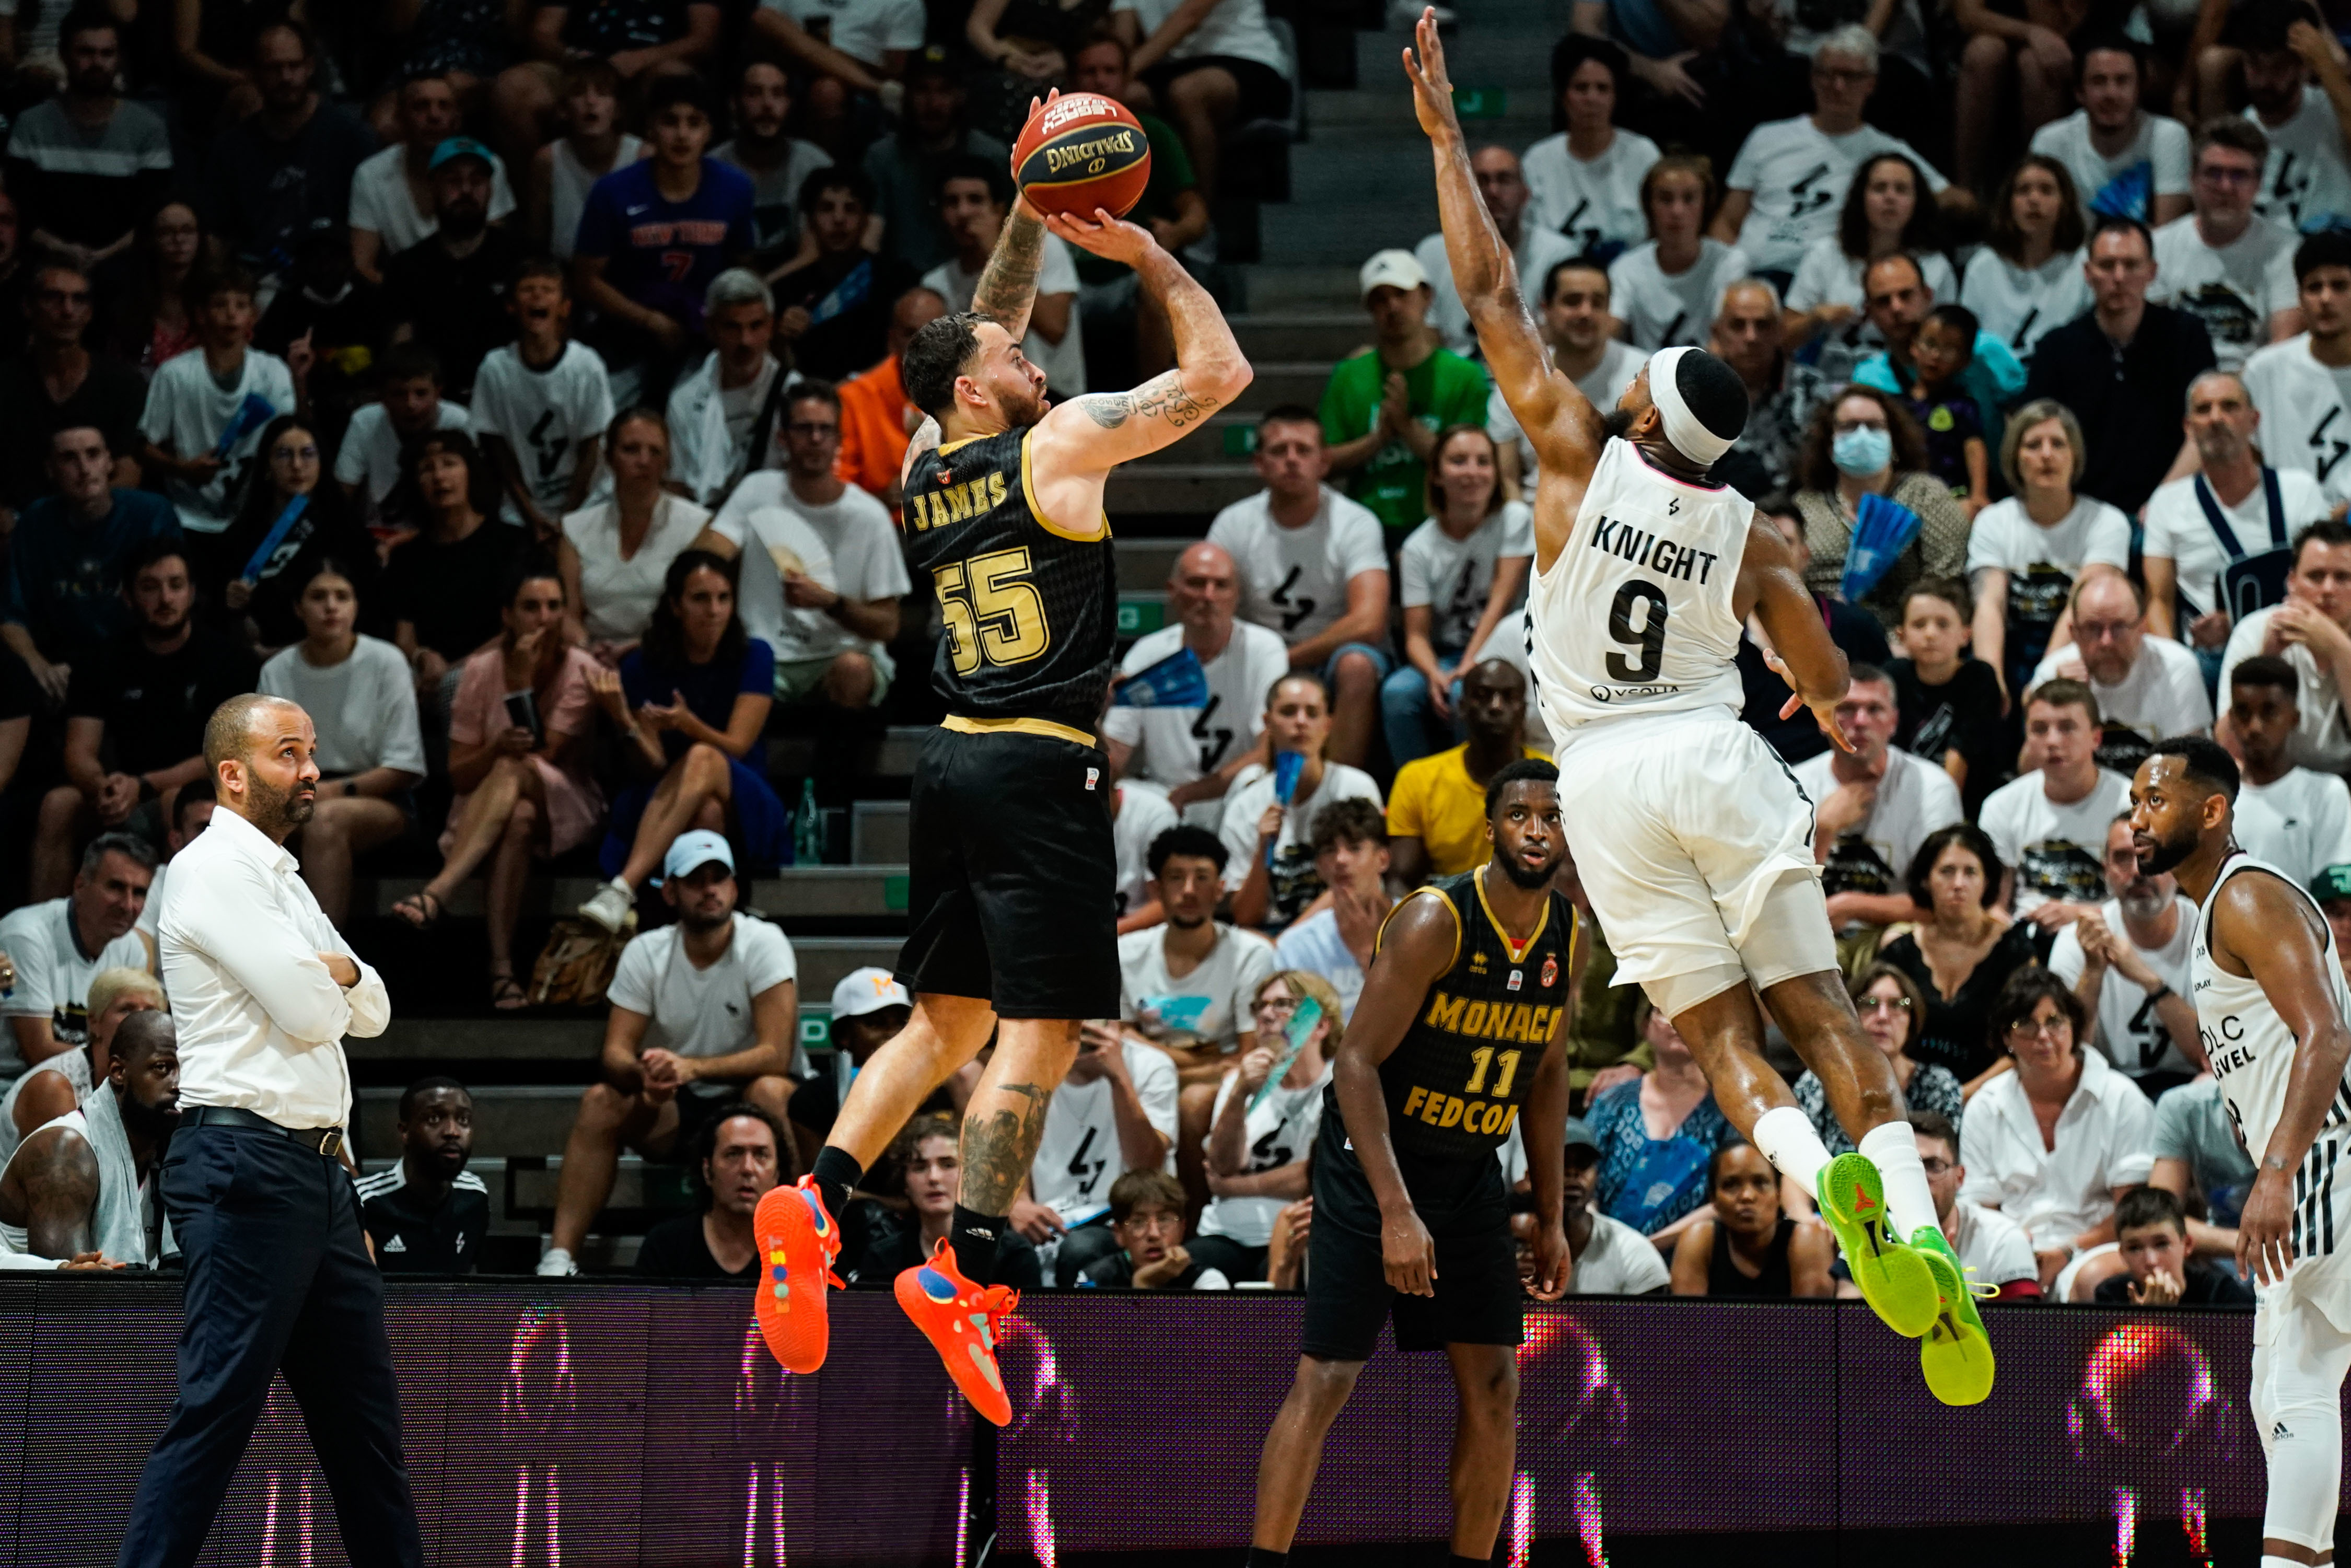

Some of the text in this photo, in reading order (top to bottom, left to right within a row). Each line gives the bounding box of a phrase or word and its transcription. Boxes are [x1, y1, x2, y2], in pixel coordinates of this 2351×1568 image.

[1046, 130, 1134, 174] SPALDING
[660, 251, 695, 281] 7
[913, 471, 1007, 531] JAMES
[1591, 516, 1717, 585] KNIGHT
[932, 545, 1050, 677] 55
[1606, 579, 1668, 682] 9
[871, 977, 897, 996] M
[800, 1019, 827, 1041] D
[1464, 1046, 1522, 1098] 11
